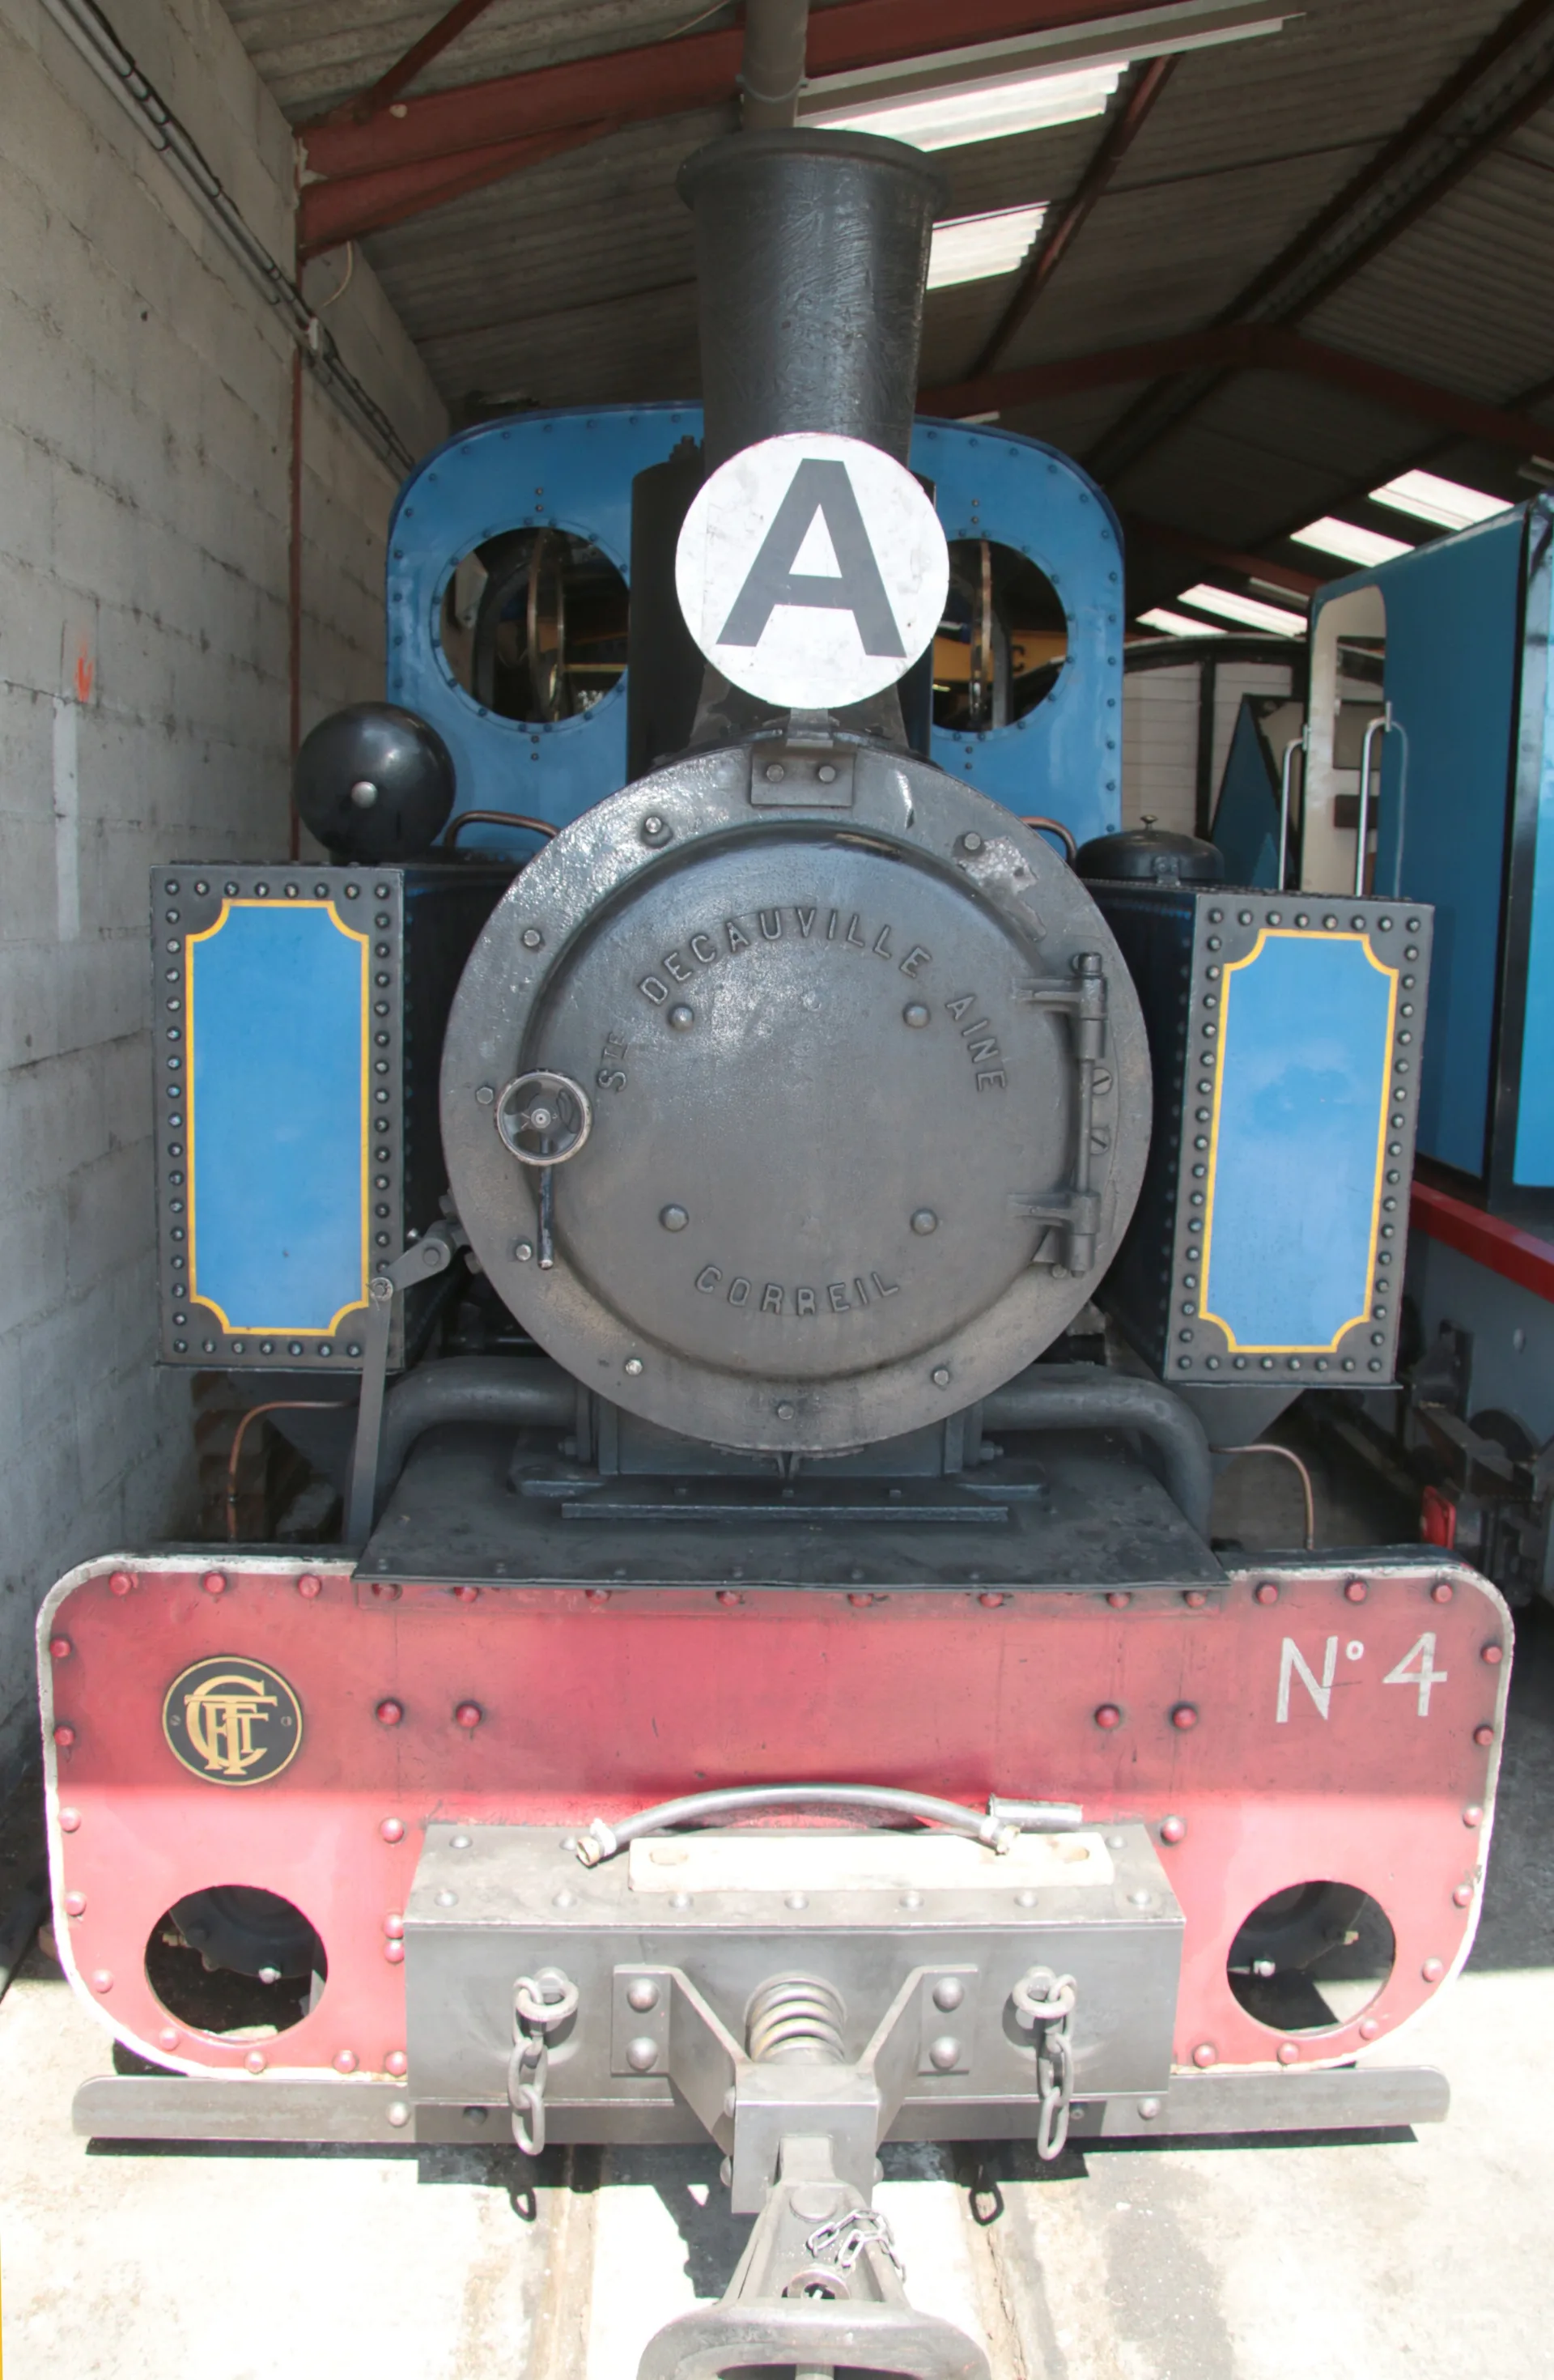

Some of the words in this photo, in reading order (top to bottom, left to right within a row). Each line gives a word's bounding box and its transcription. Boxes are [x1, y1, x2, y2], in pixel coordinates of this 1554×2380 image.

[715, 458, 906, 658] A
[638, 907, 932, 1006] DECAUVILLE
[946, 994, 1008, 1092] AINE
[1382, 1631, 1448, 1717] 4
